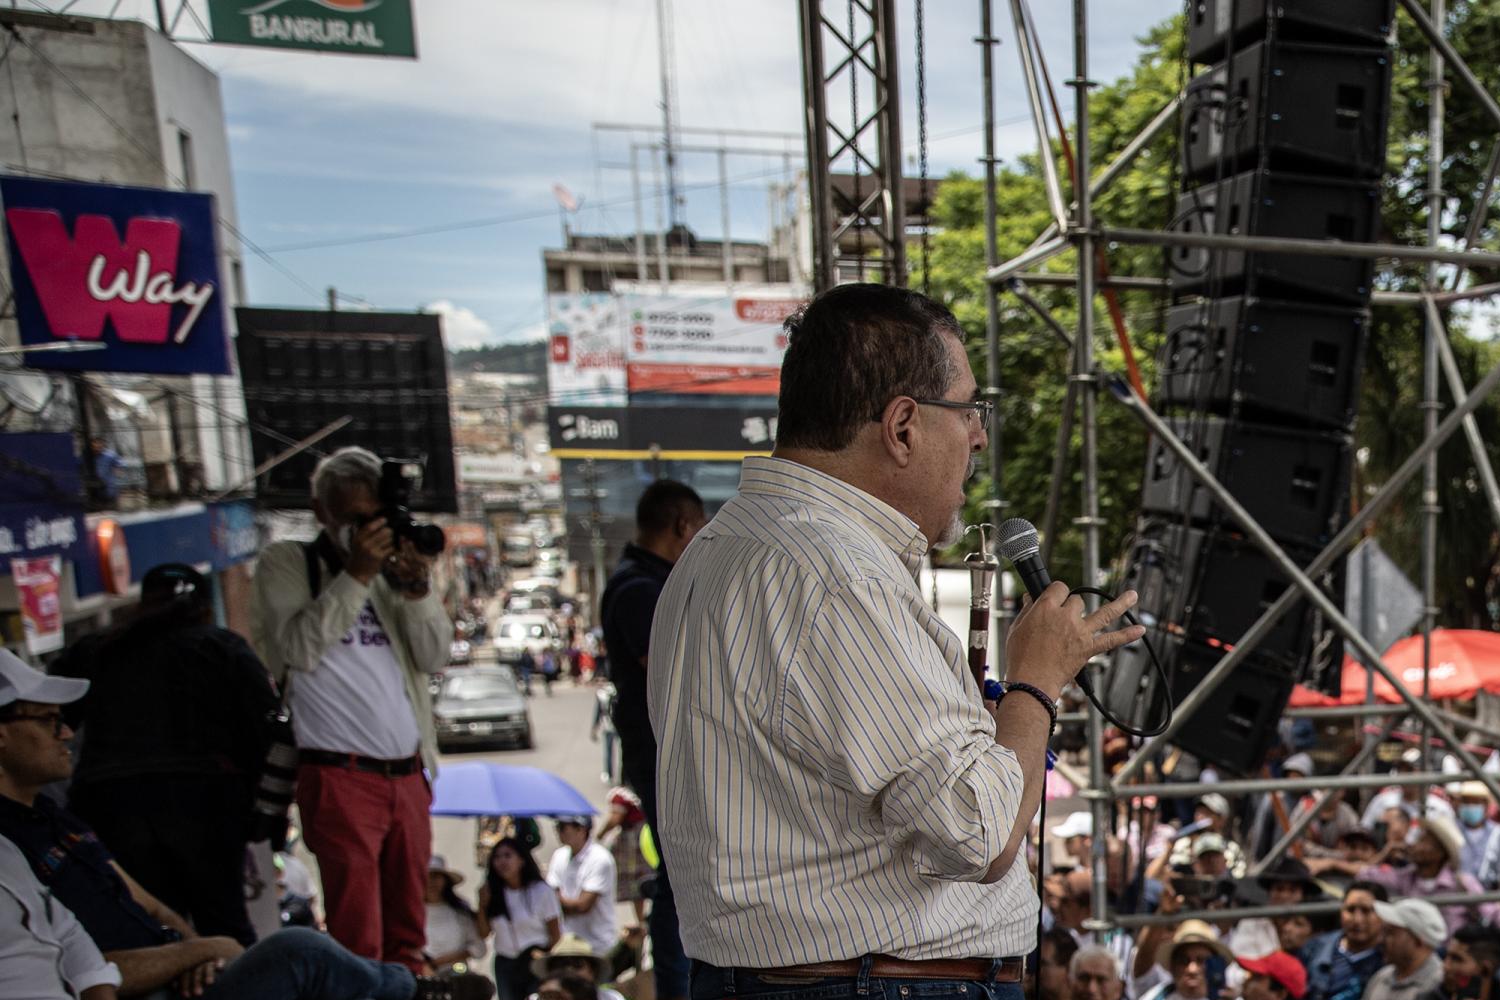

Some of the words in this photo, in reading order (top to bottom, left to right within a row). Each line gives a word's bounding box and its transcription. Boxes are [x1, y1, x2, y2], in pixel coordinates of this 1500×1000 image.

[249, 14, 384, 48] BANRURAL
[87, 249, 214, 344] Way
[576, 415, 618, 440] Bam
